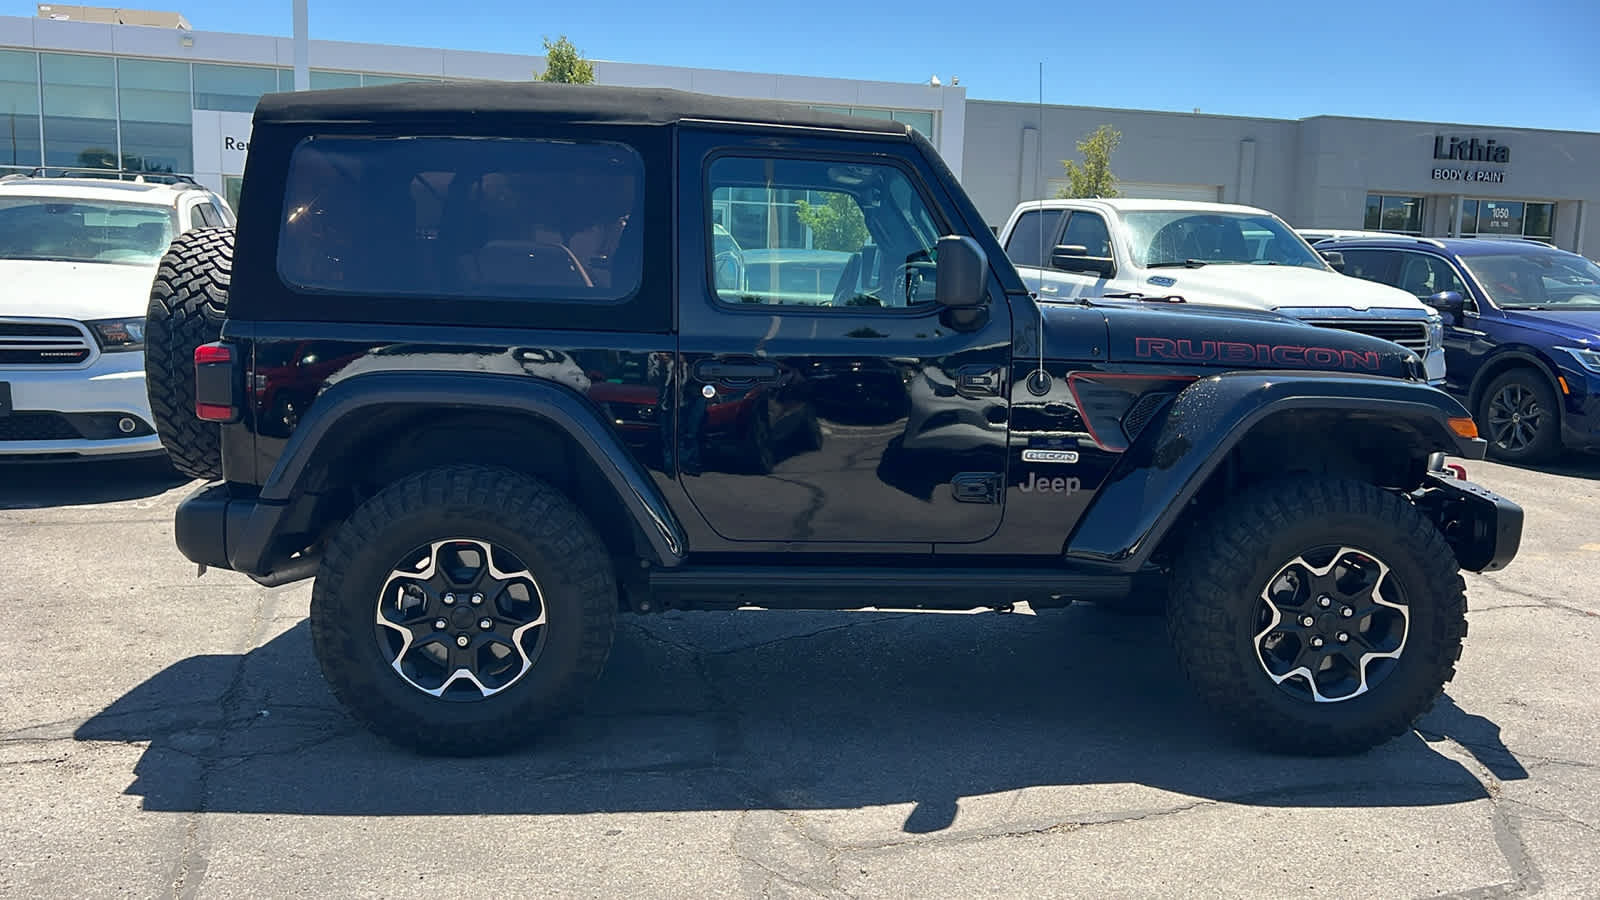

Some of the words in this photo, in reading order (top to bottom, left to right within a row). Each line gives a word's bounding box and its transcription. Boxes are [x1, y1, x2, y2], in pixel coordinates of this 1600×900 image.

[1433, 135, 1510, 163] Lithia
[1432, 168, 1462, 181] BODY
[1465, 170, 1474, 181] &
[1475, 170, 1505, 183] PAINT
[1493, 207, 1509, 218] 1050
[1135, 337, 1381, 370] RUBICON
[1026, 452, 1075, 460] RECON
[1019, 471, 1081, 496] Jeep
